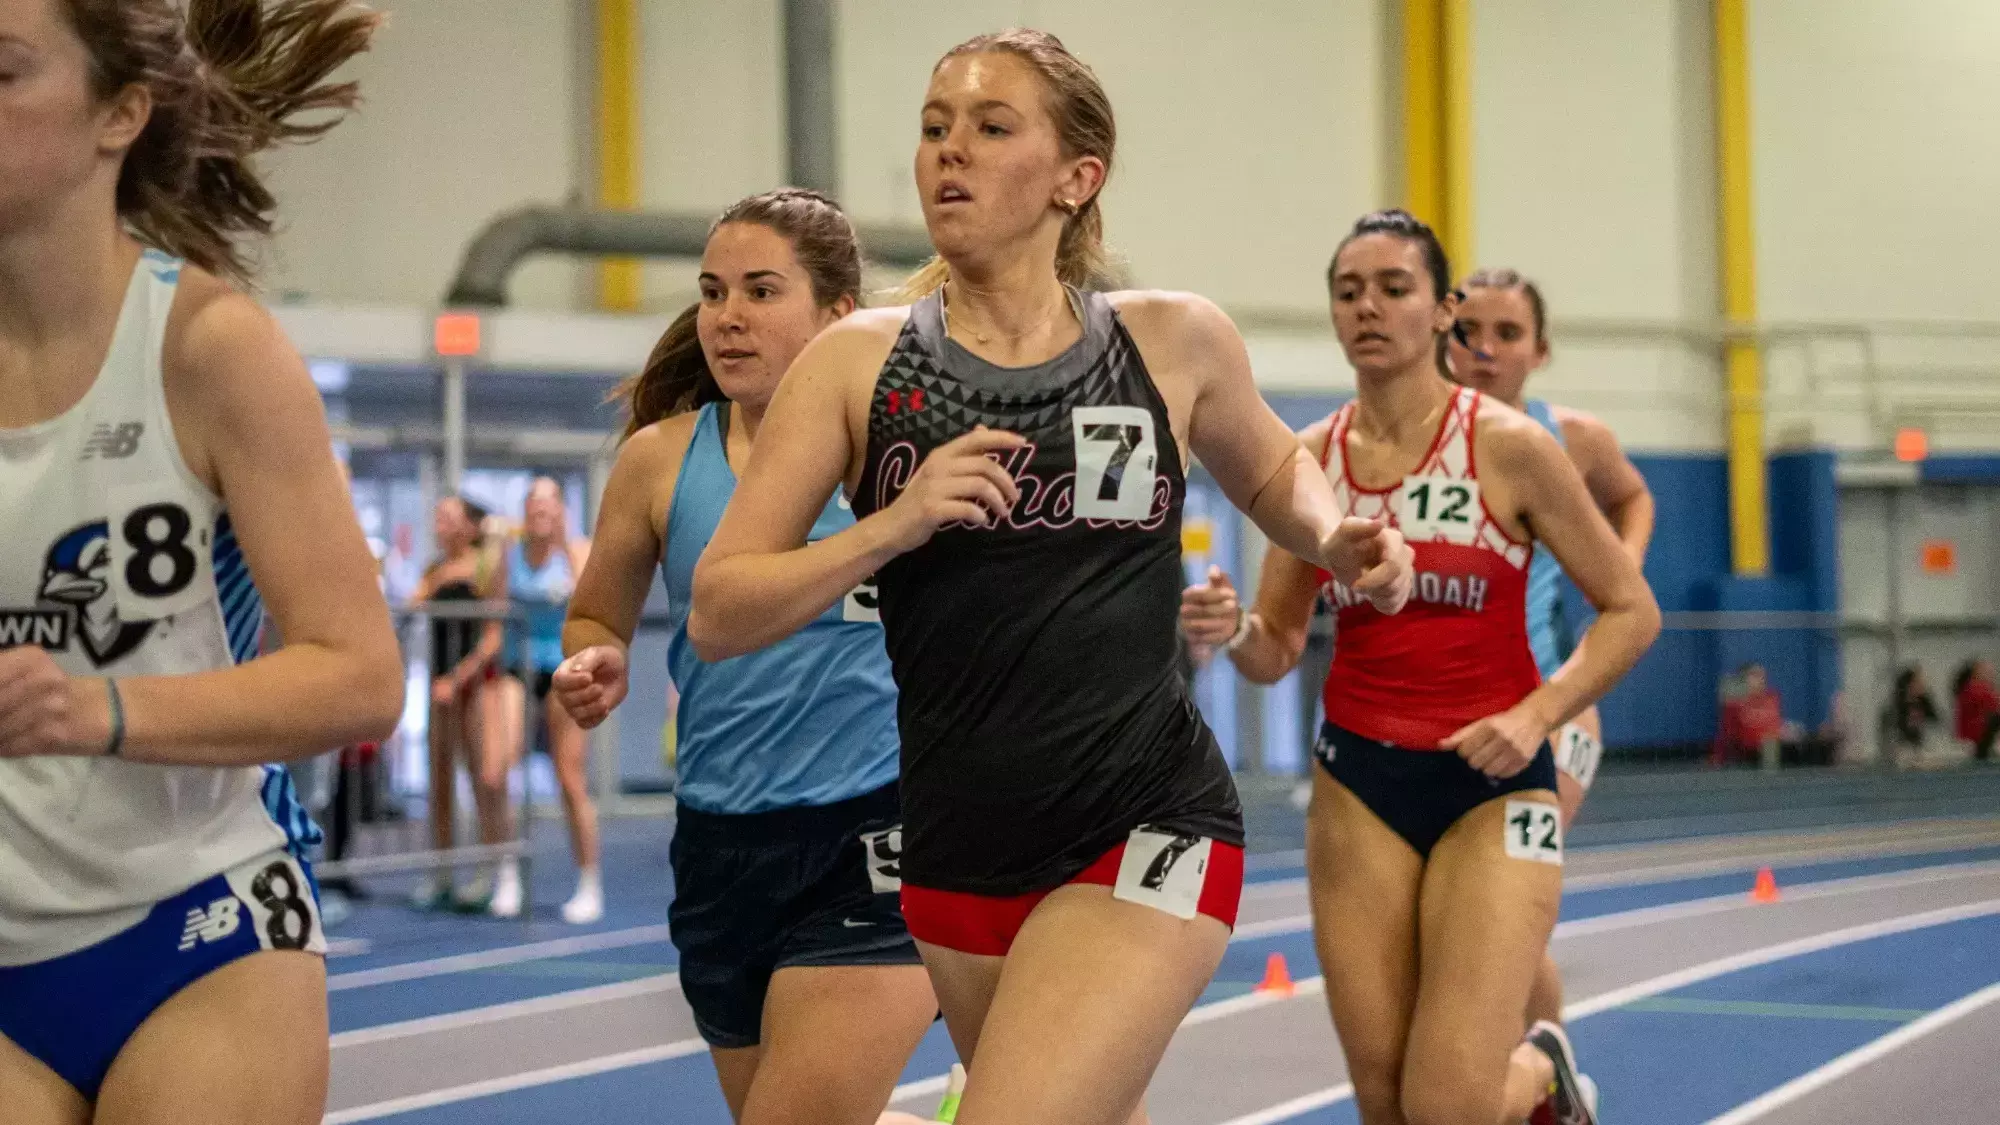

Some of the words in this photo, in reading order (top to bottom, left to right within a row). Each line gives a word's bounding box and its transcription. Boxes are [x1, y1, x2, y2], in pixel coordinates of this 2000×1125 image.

[876, 441, 1170, 530] Choc
[1082, 424, 1143, 501] 7
[1408, 483, 1470, 524] 12
[122, 502, 197, 598] 8
[1139, 827, 1201, 893] 7
[1510, 808, 1557, 851] 12
[178, 896, 241, 951] NB
[252, 861, 312, 950] 8
